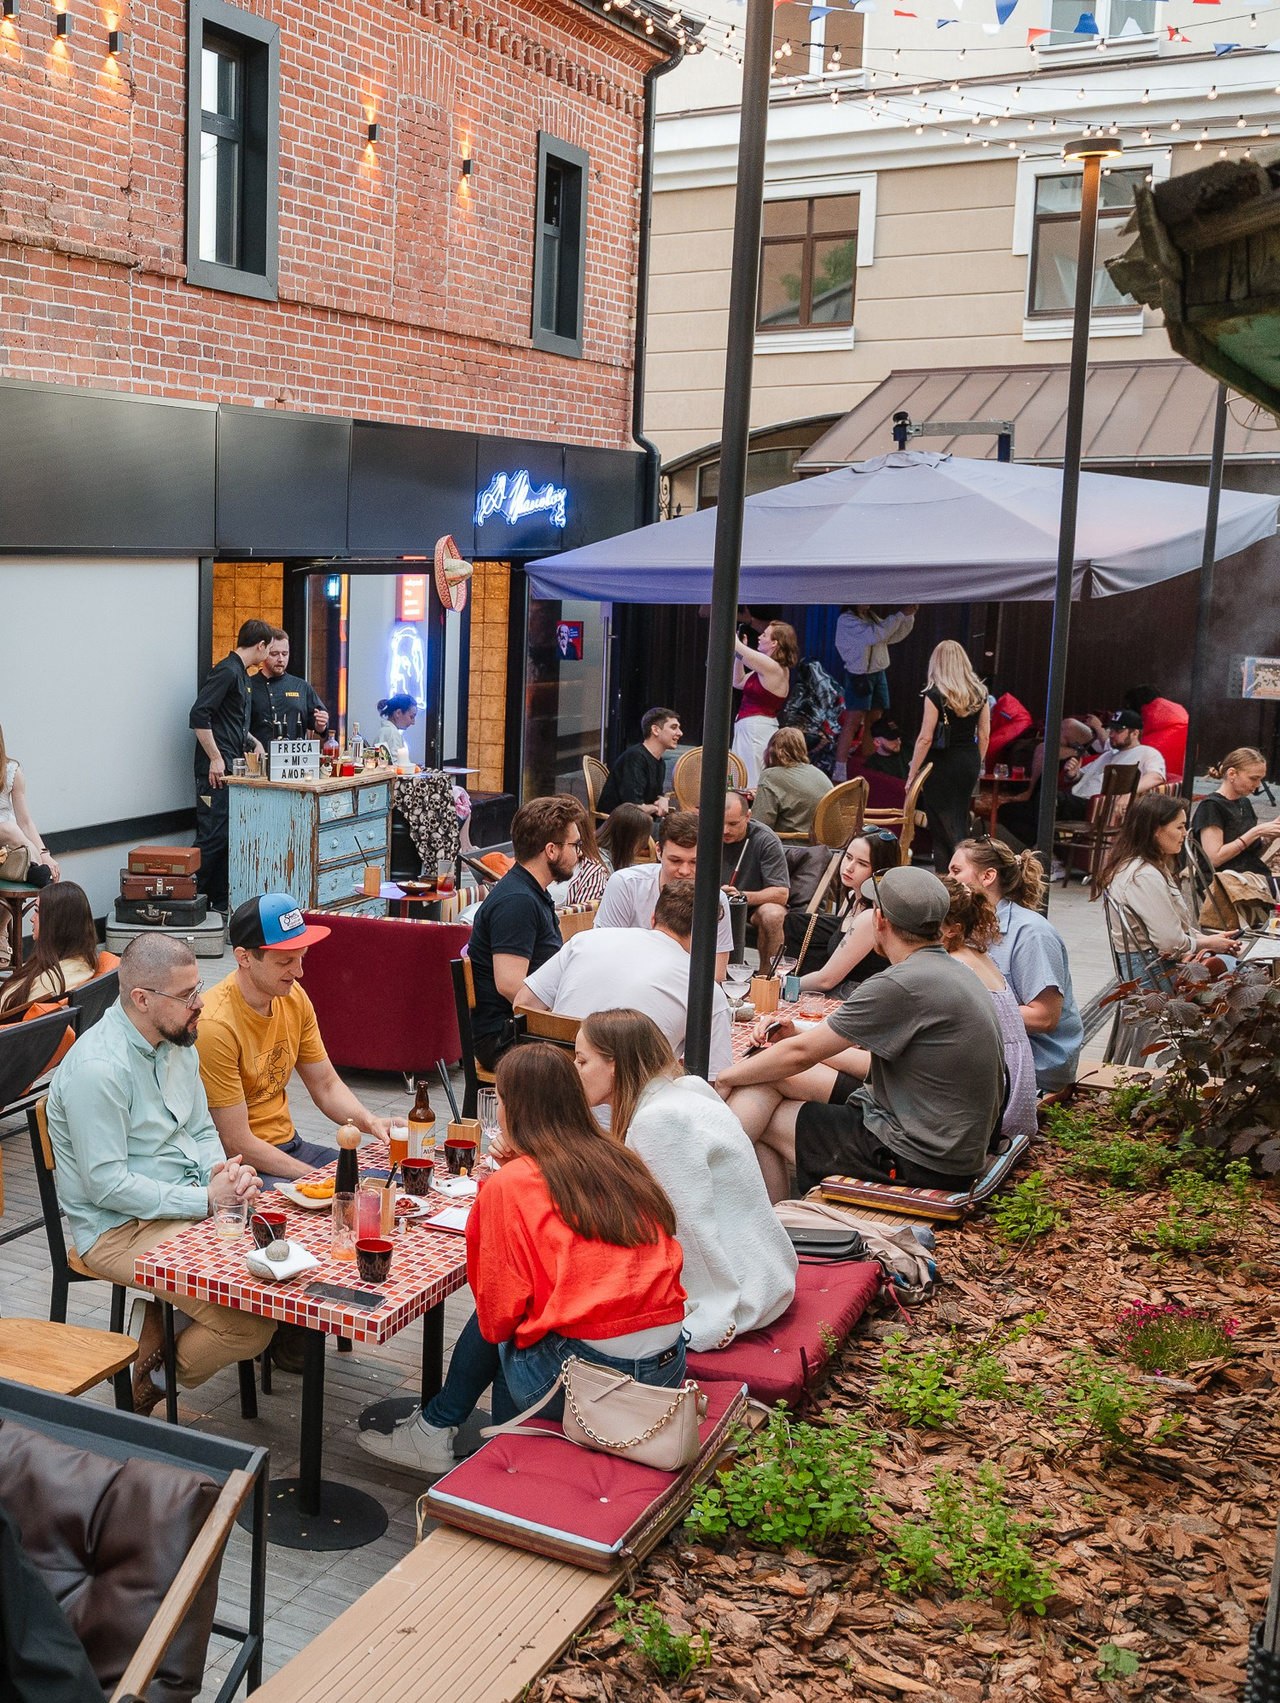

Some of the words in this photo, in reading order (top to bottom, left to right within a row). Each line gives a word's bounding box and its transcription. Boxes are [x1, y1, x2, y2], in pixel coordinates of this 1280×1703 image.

[278, 743, 313, 753] FRESCA
[291, 755, 300, 766] MI
[281, 769, 305, 779] AMOR
